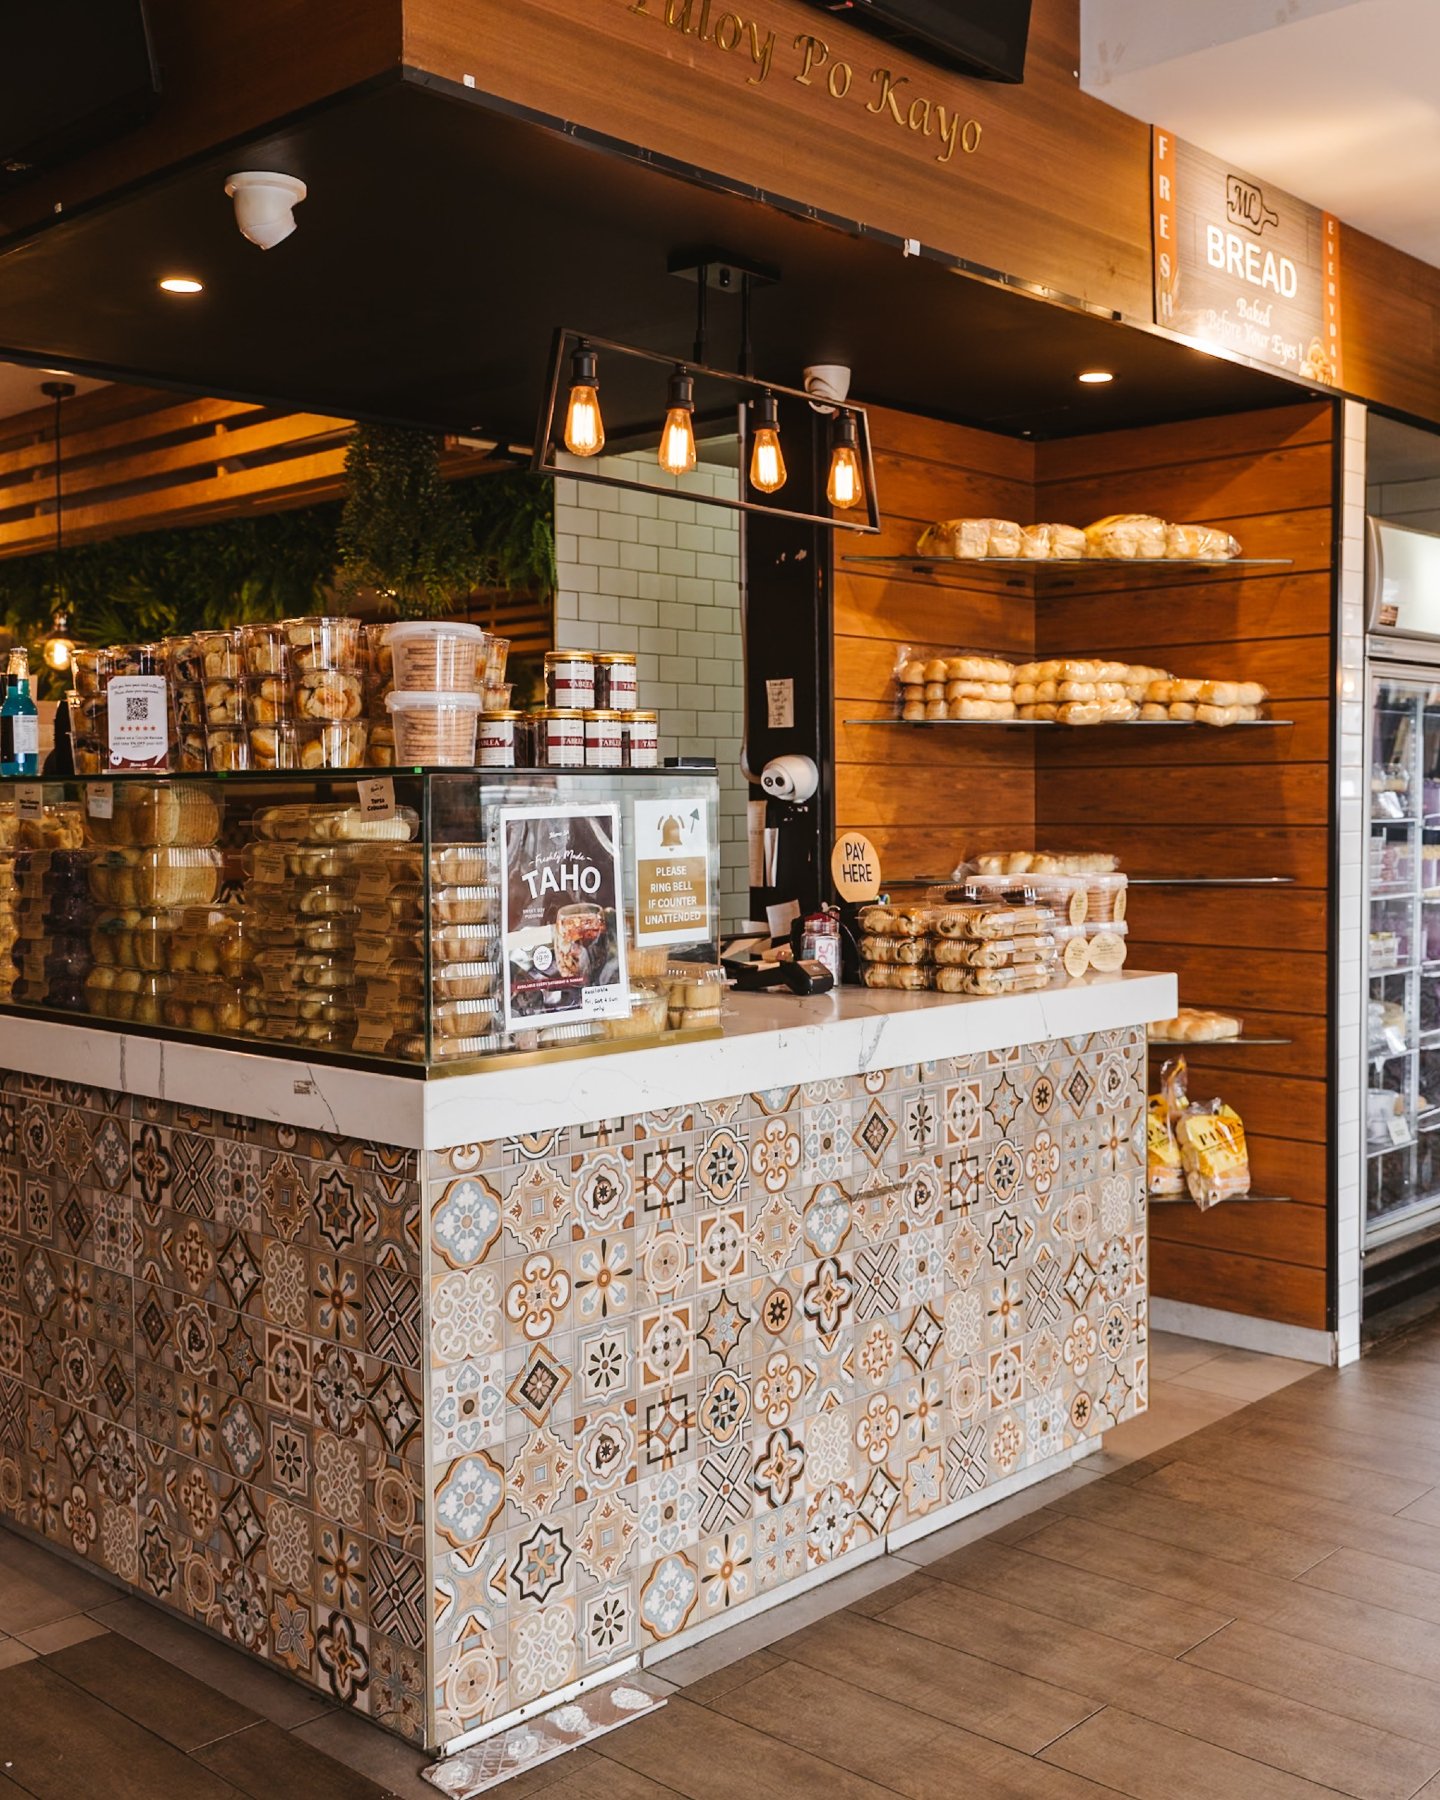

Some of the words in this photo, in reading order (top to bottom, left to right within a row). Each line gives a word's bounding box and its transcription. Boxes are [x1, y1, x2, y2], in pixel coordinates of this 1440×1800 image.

[627, 0, 776, 86] uloy
[794, 34, 853, 99] Po
[866, 69, 983, 162] Kayo
[1158, 135, 1174, 317] FRESH
[1206, 224, 1298, 299] BREAD
[1327, 220, 1338, 378] EVERYDAY
[1236, 297, 1273, 328] Baked
[845, 842, 866, 861] PAY
[521, 863, 601, 900] TAHO
[655, 865, 687, 877] PLEASE
[842, 863, 873, 883] HERE
[650, 882, 672, 893] RING
[672, 880, 693, 891] BELL
[648, 899, 656, 909] IF
[657, 896, 697, 908] COUNTER
[645, 911, 701, 925] UNATTENDED
